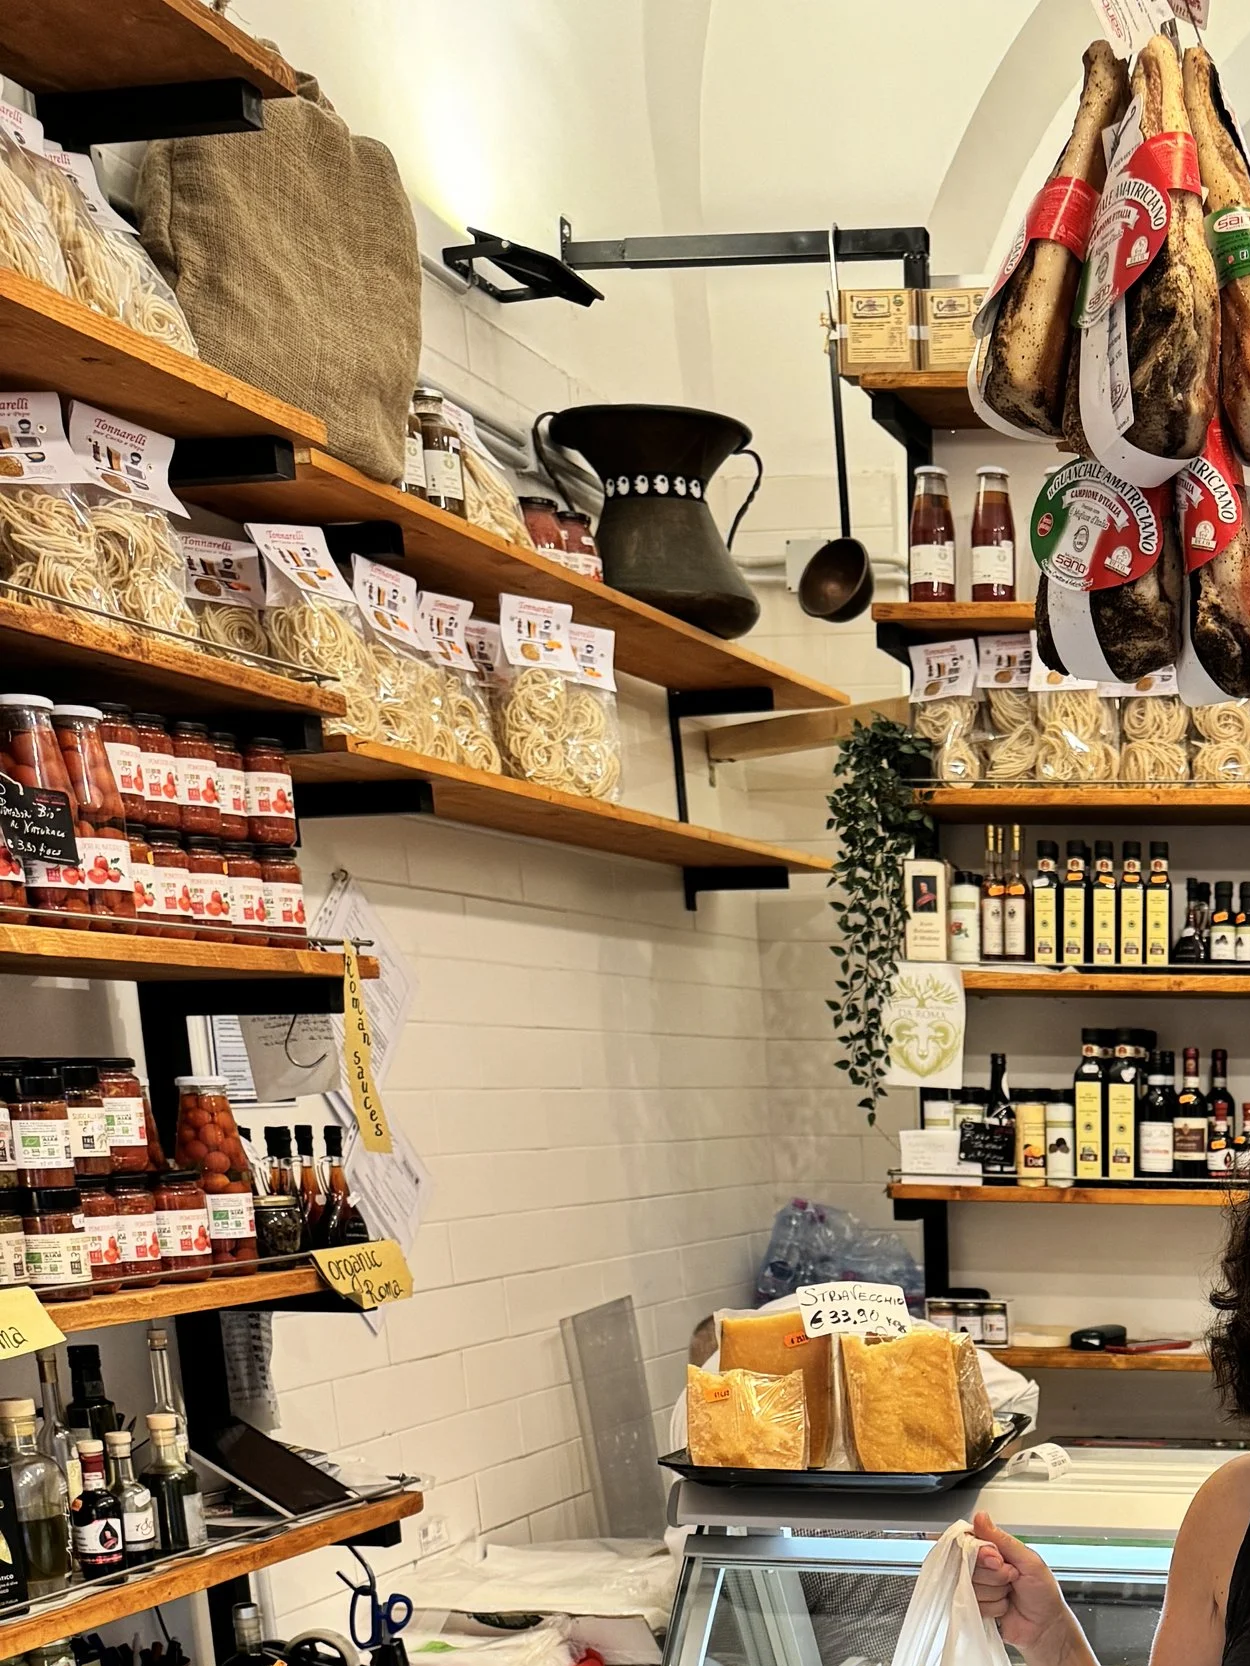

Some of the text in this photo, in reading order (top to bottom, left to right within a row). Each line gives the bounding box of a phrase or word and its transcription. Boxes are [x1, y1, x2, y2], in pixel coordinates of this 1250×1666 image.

[94, 417, 147, 446] Tonnarelli
[1103, 470, 1155, 553] AMATRICIANO
[1187, 457, 1234, 521] TRICIANO
[353, 1050, 383, 1137] sauces
[327, 1247, 383, 1294] organic
